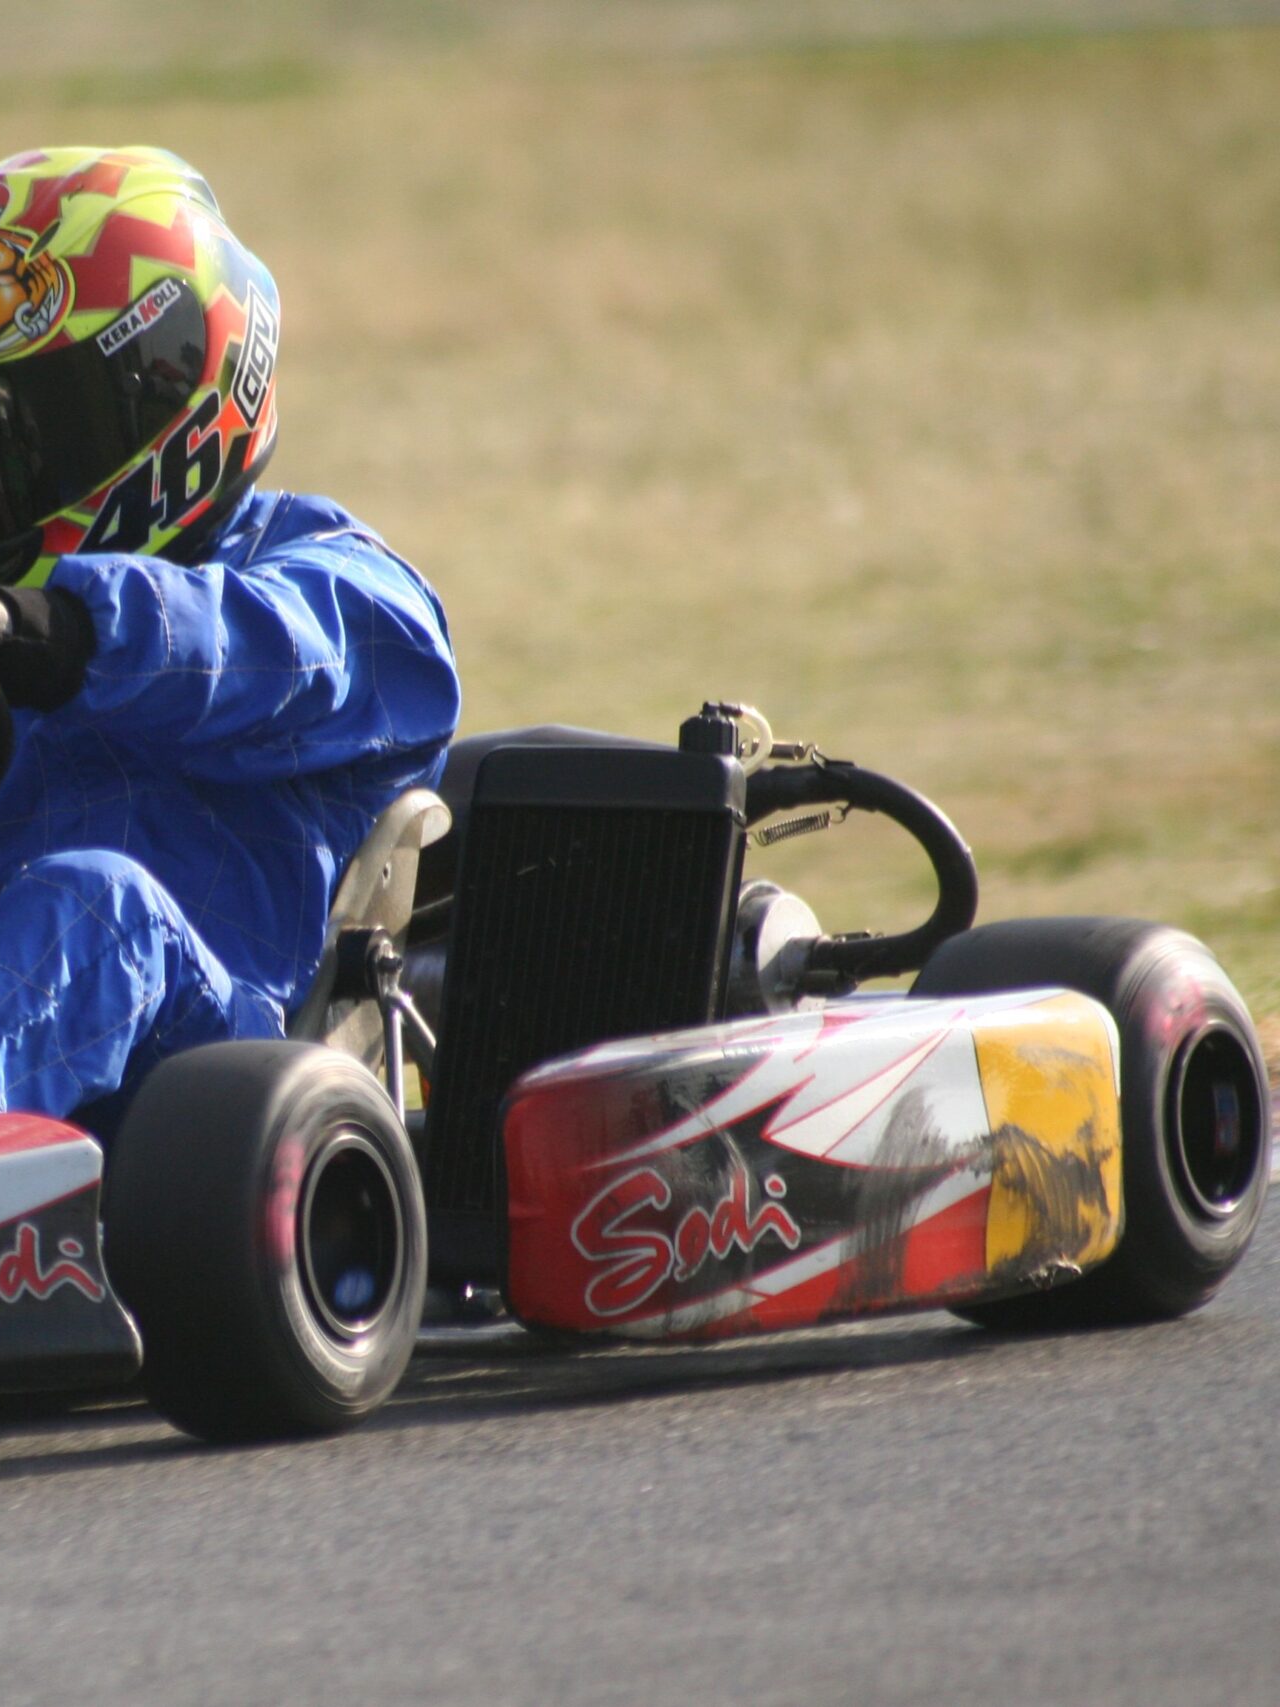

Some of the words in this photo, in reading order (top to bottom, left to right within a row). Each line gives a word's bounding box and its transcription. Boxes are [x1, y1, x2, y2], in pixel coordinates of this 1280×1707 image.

[100, 283, 178, 351] KERAKOLL
[238, 293, 277, 410] agv
[75, 388, 222, 552] 46
[570, 1166, 802, 1317] Sodi
